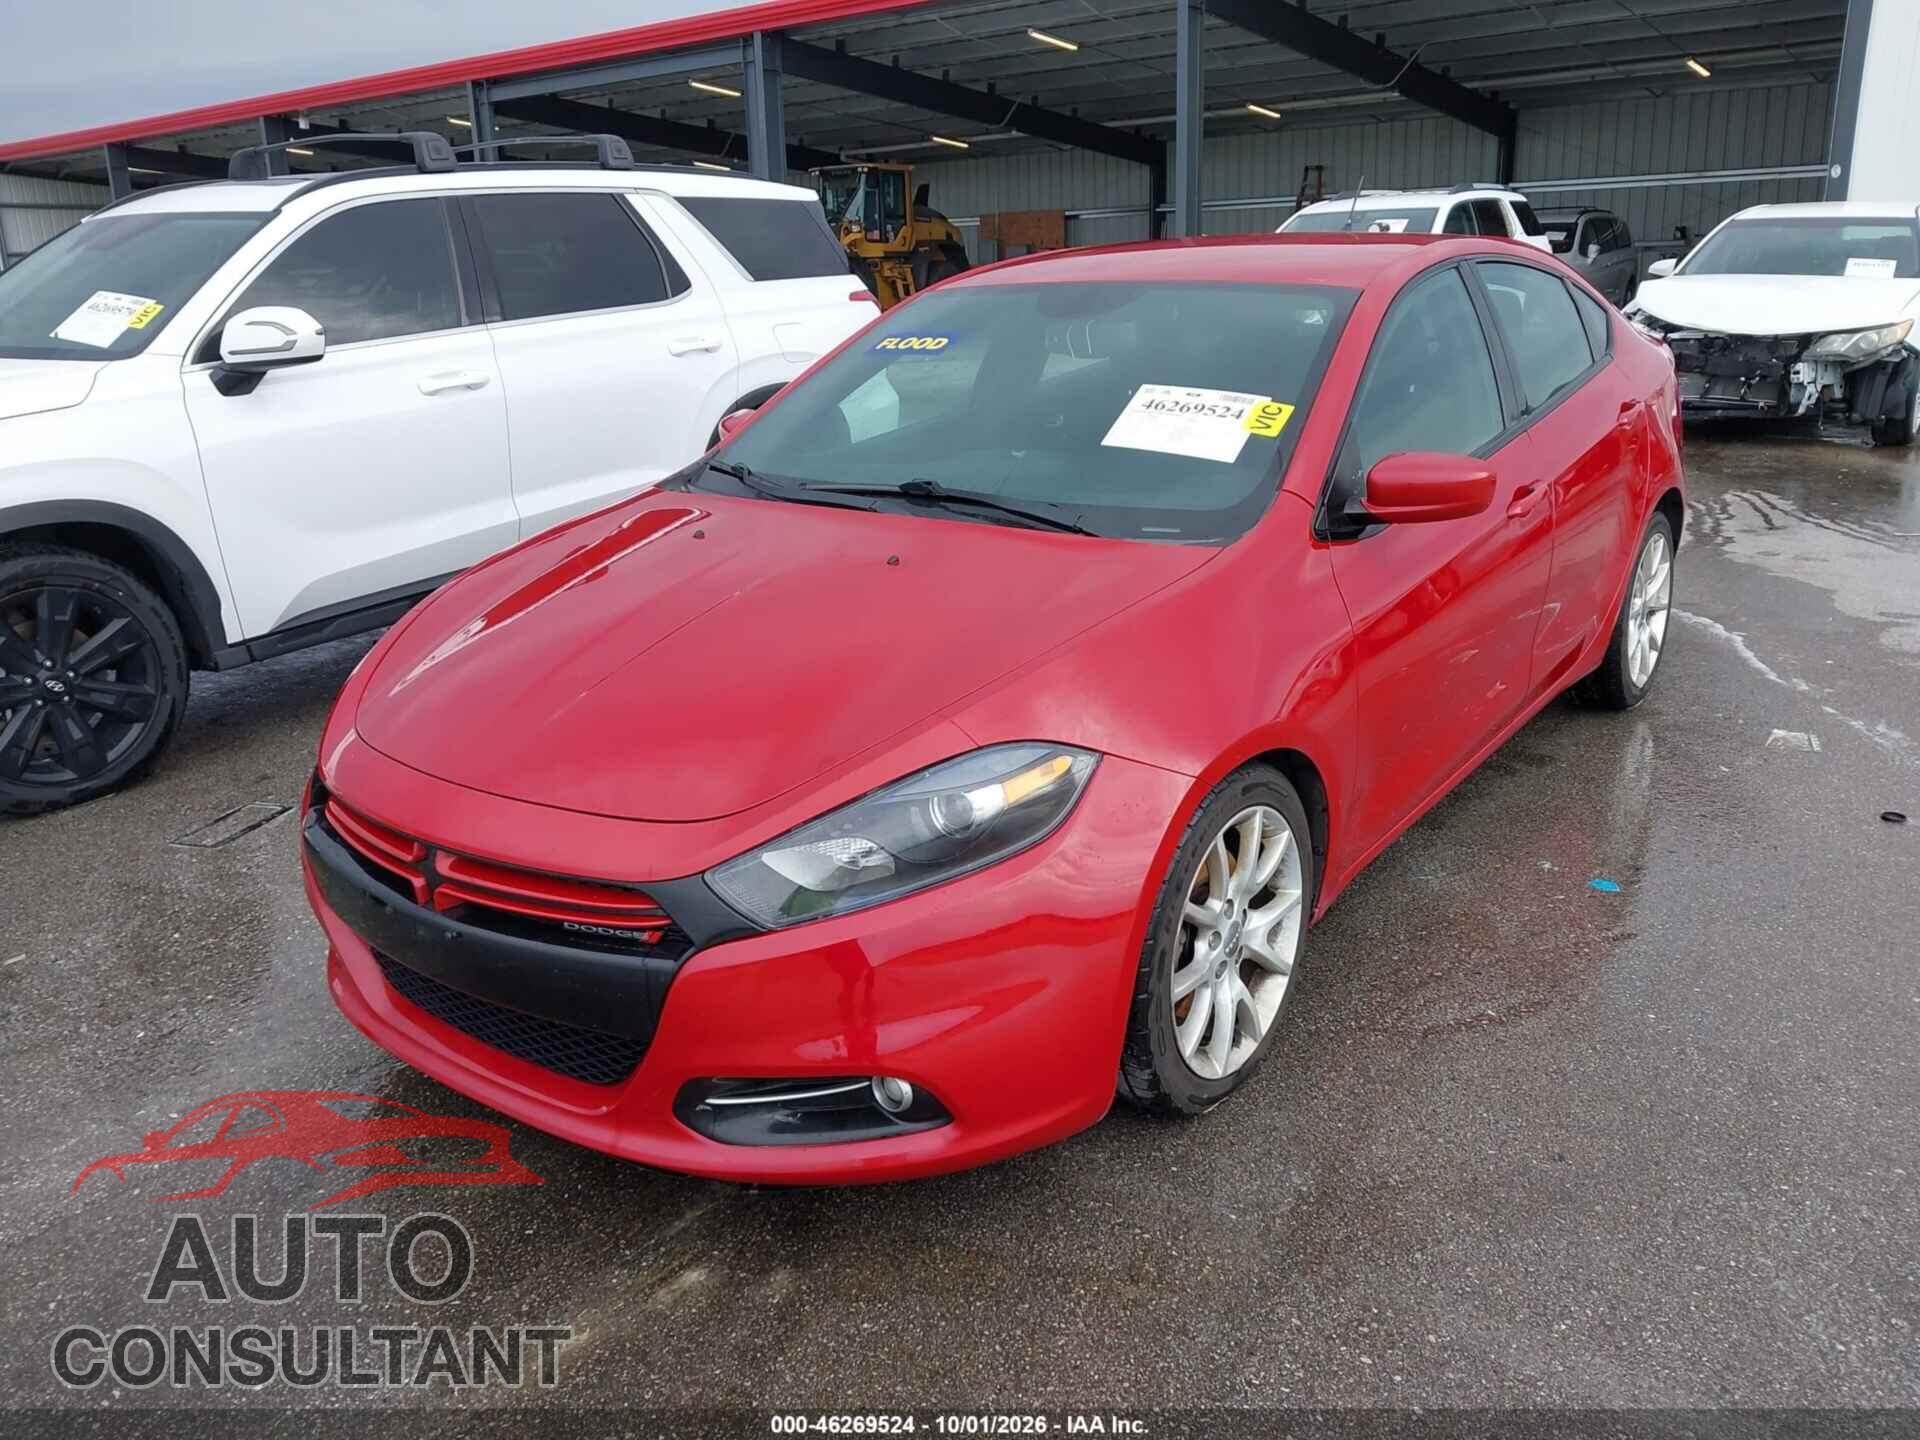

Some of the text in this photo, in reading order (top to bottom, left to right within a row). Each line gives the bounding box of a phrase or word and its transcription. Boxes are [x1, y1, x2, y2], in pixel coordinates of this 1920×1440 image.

[130, 305, 157, 326] VIC
[875, 336, 949, 350] FLOOD
[1141, 398, 1246, 420] 46269524
[1250, 404, 1283, 431] VIC
[563, 921, 645, 940] DODGE
